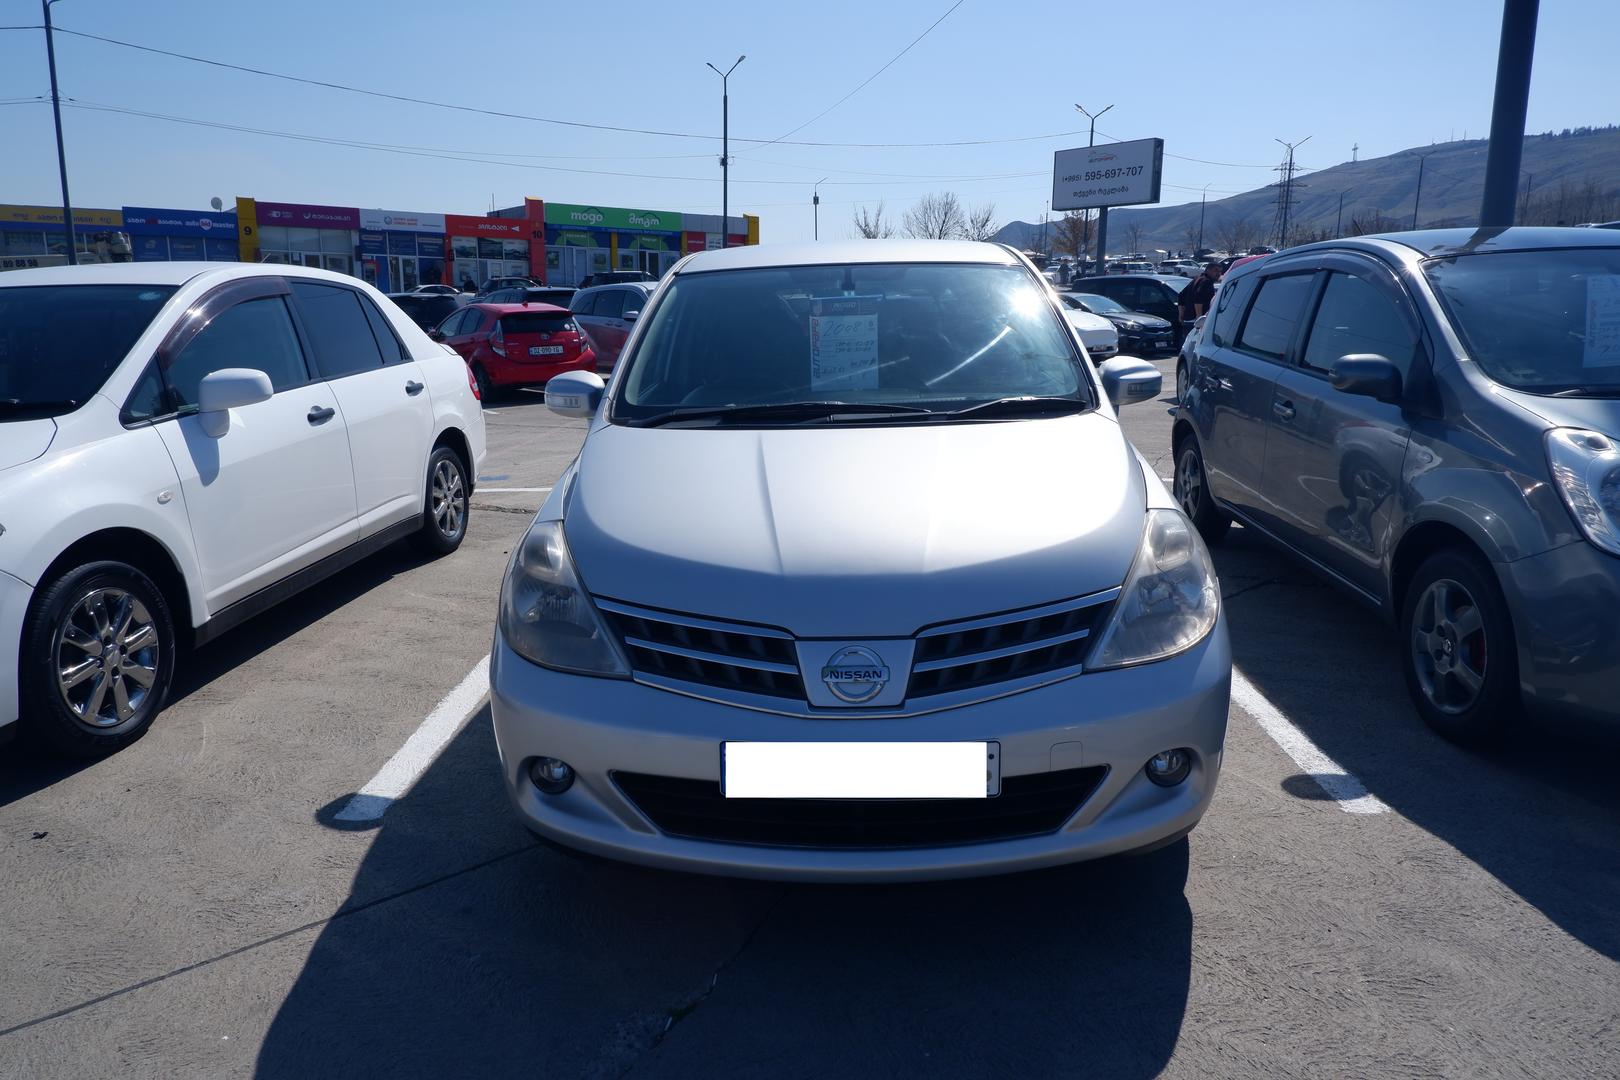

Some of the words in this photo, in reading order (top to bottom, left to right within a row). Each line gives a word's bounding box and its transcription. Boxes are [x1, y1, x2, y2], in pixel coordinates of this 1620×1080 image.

[1084, 165, 1144, 182] 595-697-707
[571, 211, 603, 225] mogo
[243, 226, 252, 236] 9
[532, 230, 543, 239] 10
[829, 670, 882, 680] NISSAN
